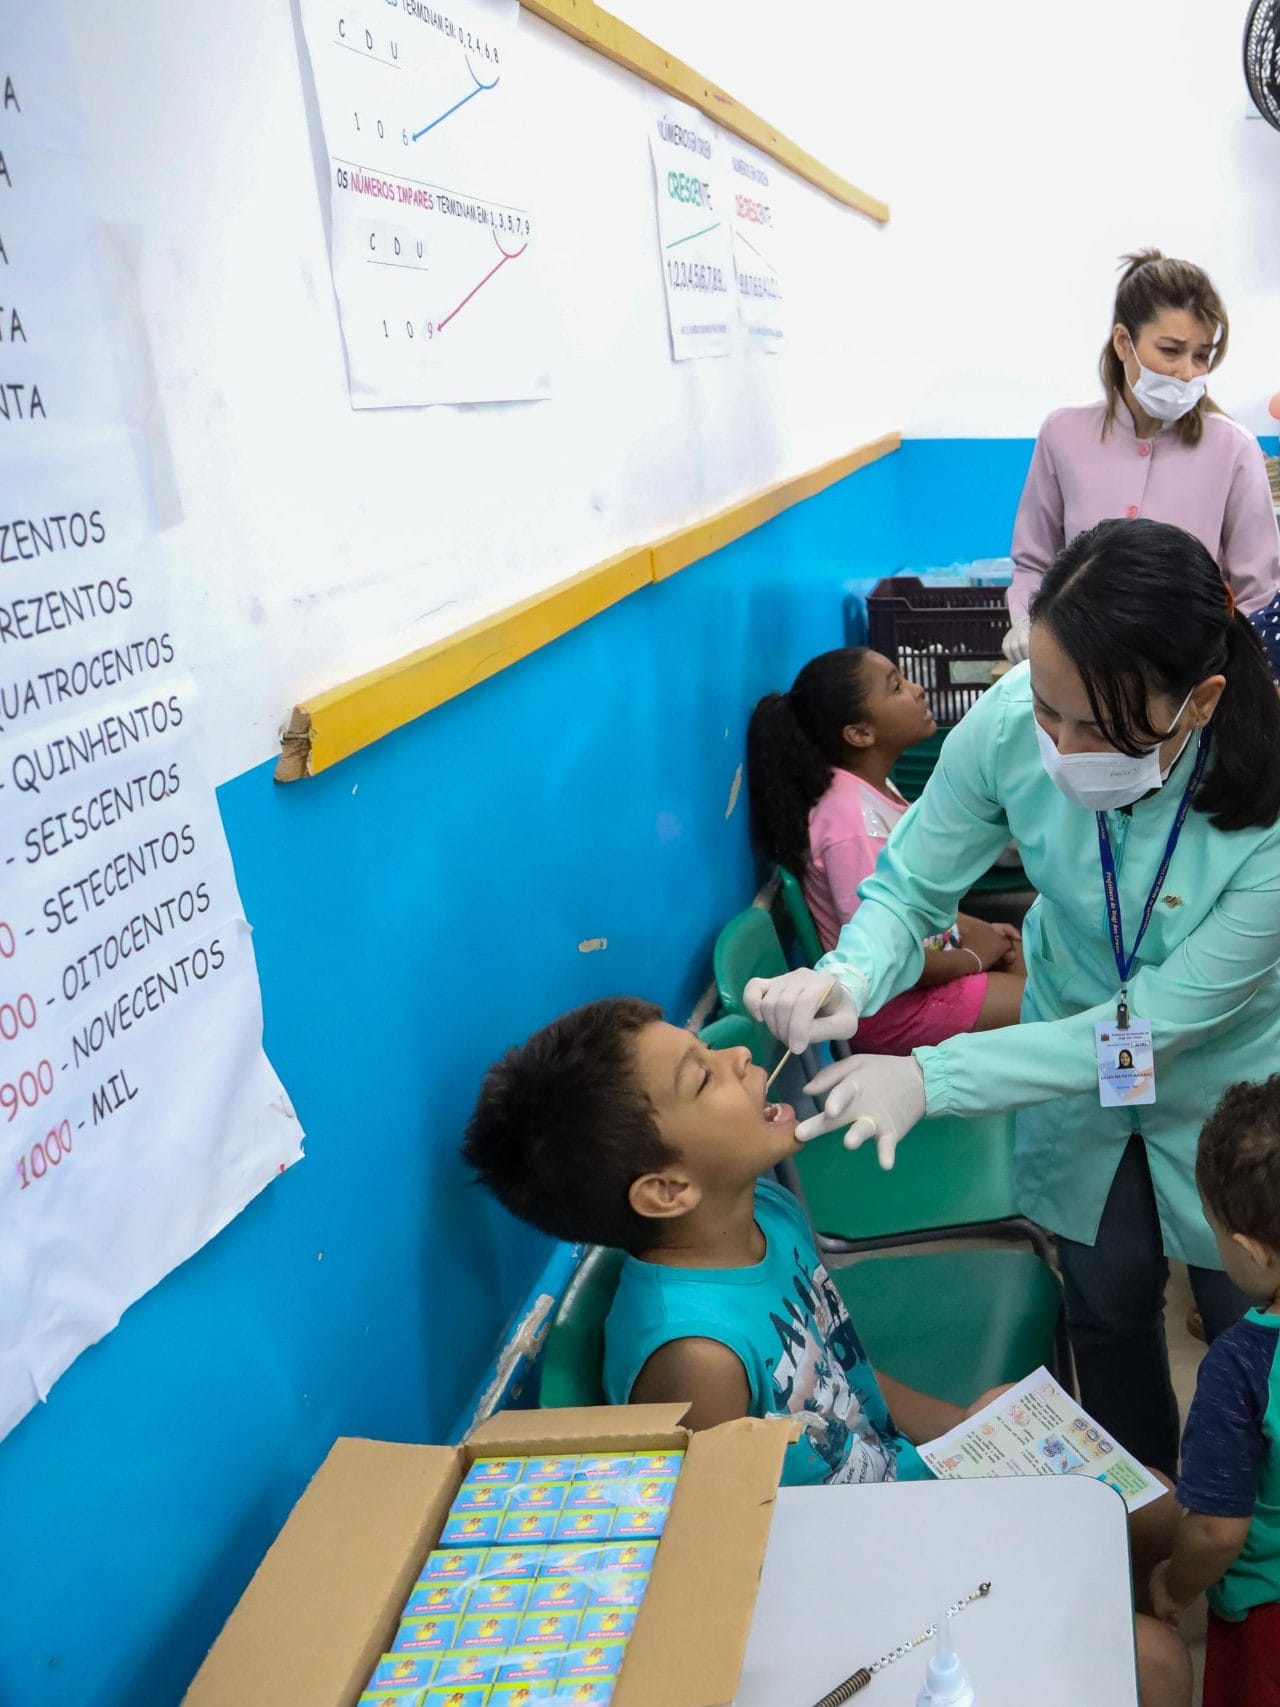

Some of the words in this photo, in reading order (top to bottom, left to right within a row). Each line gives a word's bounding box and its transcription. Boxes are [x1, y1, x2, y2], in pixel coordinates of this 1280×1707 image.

[338, 19, 345, 38] C
[366, 29, 373, 50] D
[391, 41, 398, 60] U
[354, 112, 360, 131] 1
[377, 120, 384, 139] 0
[402, 128, 408, 147] 6
[337, 168, 348, 189] OS
[351, 168, 395, 201] NÚMEROS
[436, 195, 476, 221] TERMINAM
[370, 233, 376, 250] C
[394, 237, 401, 255] D
[417, 241, 423, 258] U
[383, 320, 389, 337] 1
[407, 321, 414, 338] 0
[427, 322, 433, 339] 9
[0, 510, 106, 563] ZENTOS
[0, 577, 133, 643] REZENTOS
[0, 633, 175, 732] UATROCENTOS
[13, 696, 183, 793] QUINHENTOS
[25, 763, 180, 863] SEISCENTOS
[43, 824, 195, 933] SETECENTOS
[62, 882, 210, 1001] OITOCENTOS
[0, 1059, 54, 1122] 900
[72, 939, 225, 1068] NOVECENTOS
[17, 1119, 73, 1190] 1000
[90, 1069, 139, 1127] MIL
